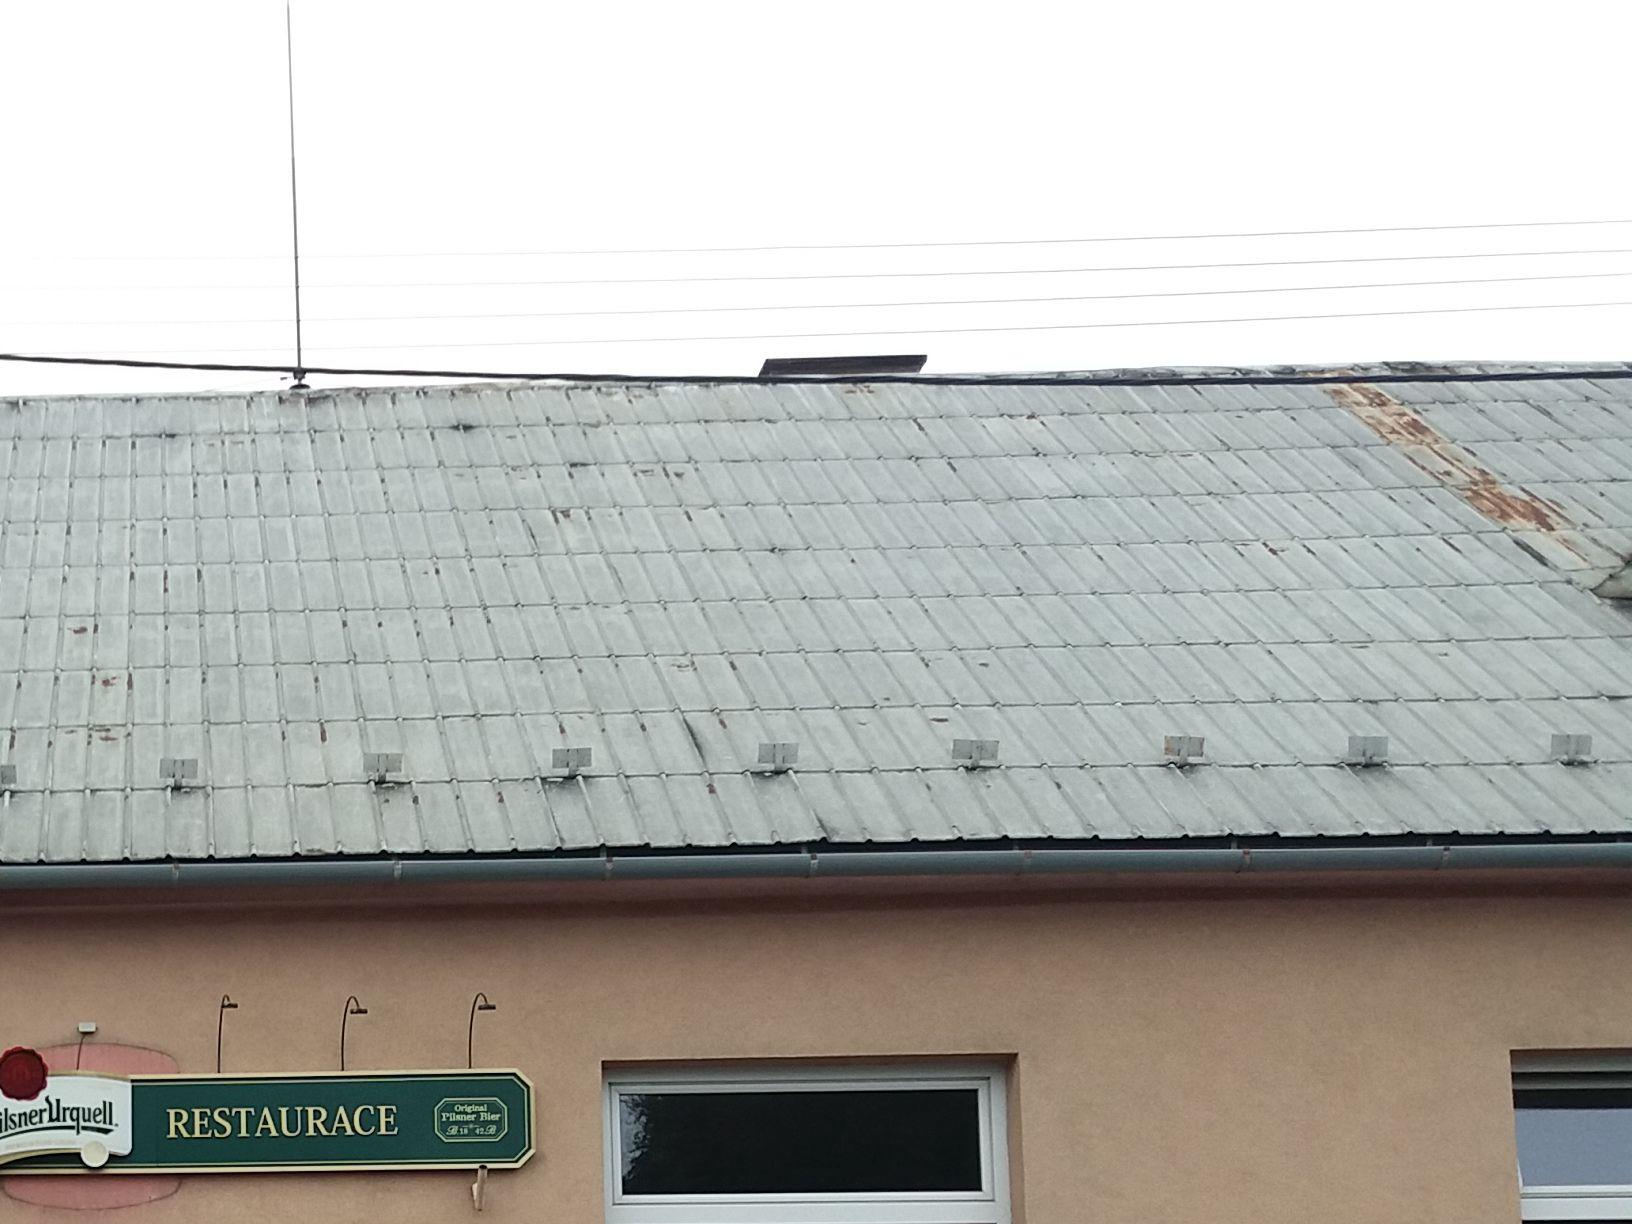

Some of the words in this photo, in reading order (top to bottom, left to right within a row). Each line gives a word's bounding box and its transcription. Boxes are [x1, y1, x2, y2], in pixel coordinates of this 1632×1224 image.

[43, 1095, 114, 1135] Urquell
[441, 1112, 477, 1121] Pilsner
[479, 1112, 501, 1121] Bier
[454, 1104, 487, 1113] Original
[166, 1104, 399, 1139] RESTAURACE
